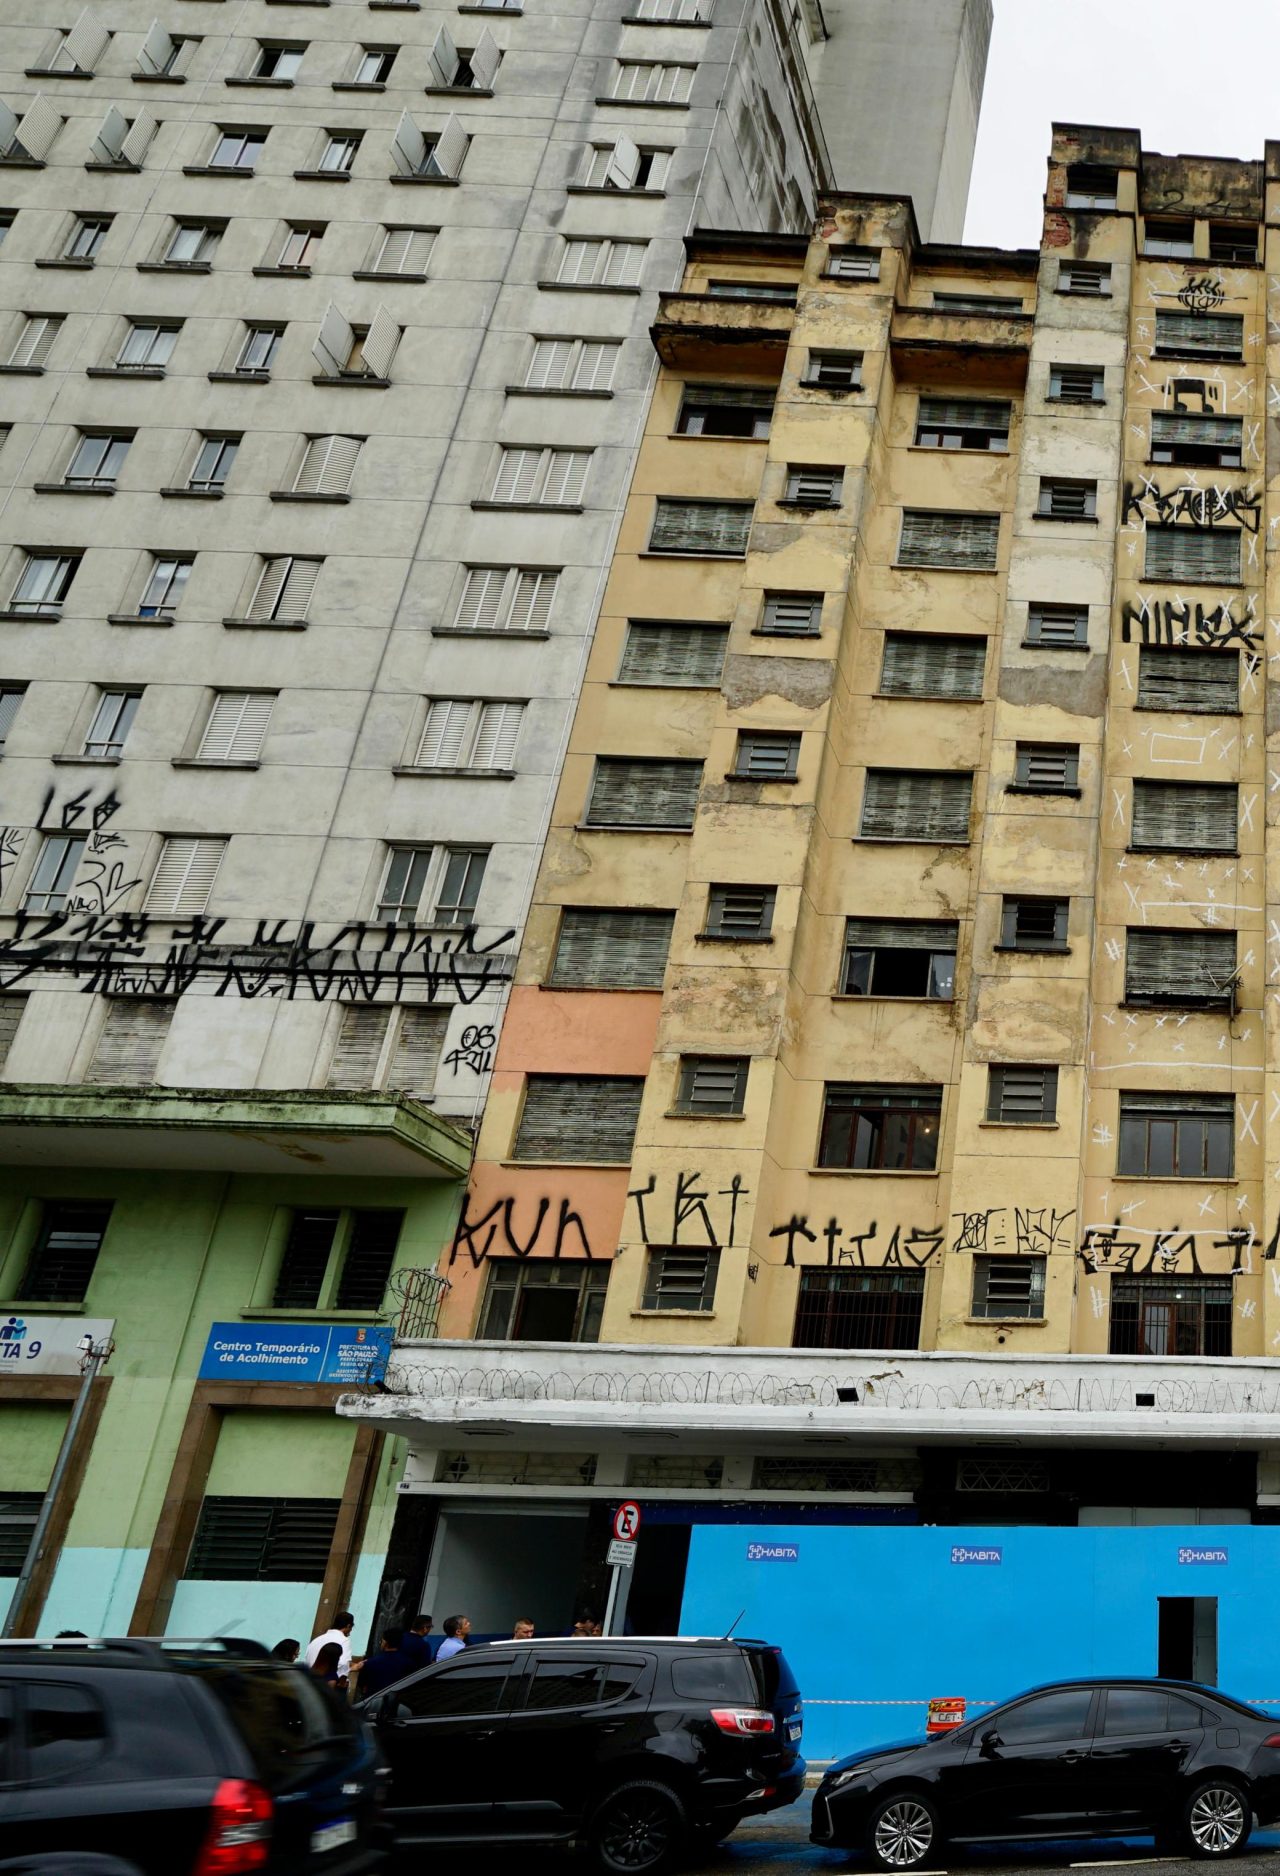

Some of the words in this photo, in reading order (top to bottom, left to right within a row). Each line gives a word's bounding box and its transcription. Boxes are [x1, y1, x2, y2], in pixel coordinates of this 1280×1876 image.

[0, 1342, 21, 1358] TA
[27, 1341, 42, 1359] 9
[213, 1341, 252, 1351] Centro
[255, 1342, 321, 1354] Temporário
[219, 1353, 234, 1362] de
[236, 1353, 309, 1364] Acolhimento
[761, 1547, 797, 1558] HABITA
[964, 1551, 1001, 1561] HABITA
[1191, 1551, 1227, 1561] HABITA
